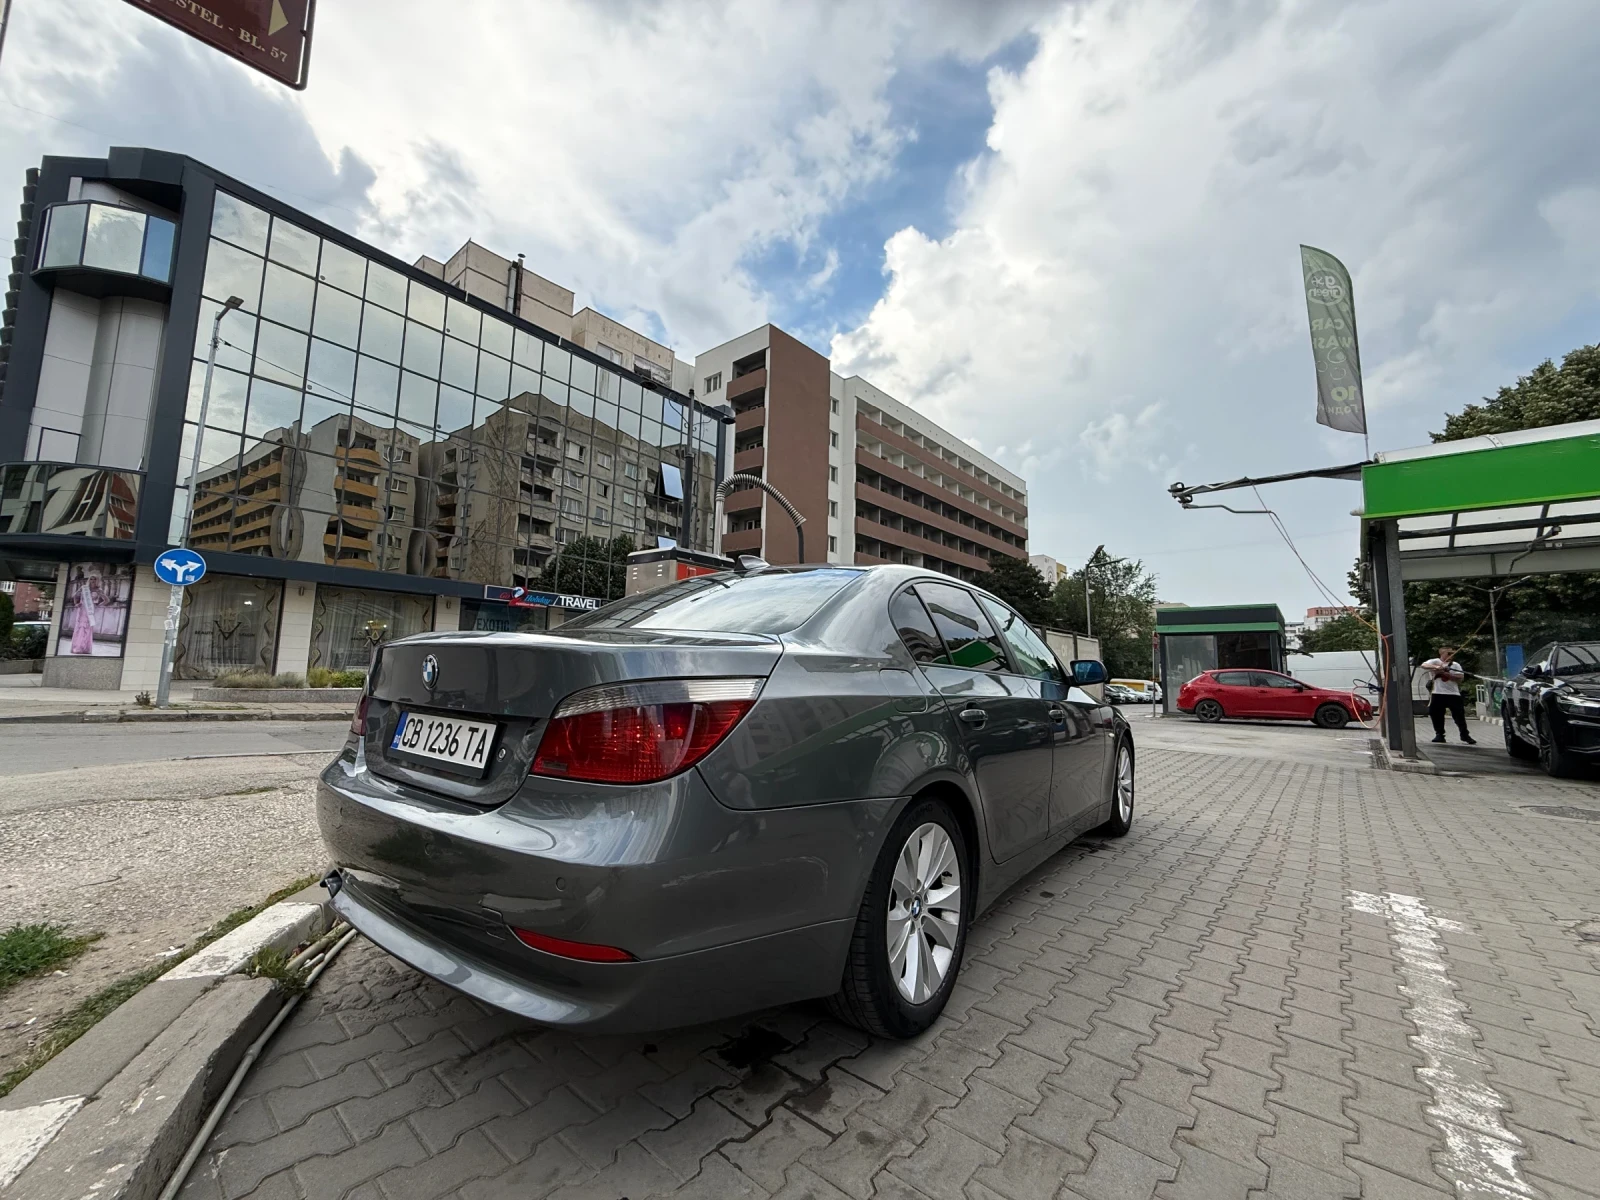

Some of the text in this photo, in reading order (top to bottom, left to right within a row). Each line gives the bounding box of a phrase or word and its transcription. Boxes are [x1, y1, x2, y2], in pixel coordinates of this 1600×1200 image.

[238, 28, 266, 52] BL.
[270, 46, 288, 62] 57
[559, 595, 599, 610] TRAVEL
[401, 718, 488, 763] CB 1236 TA
